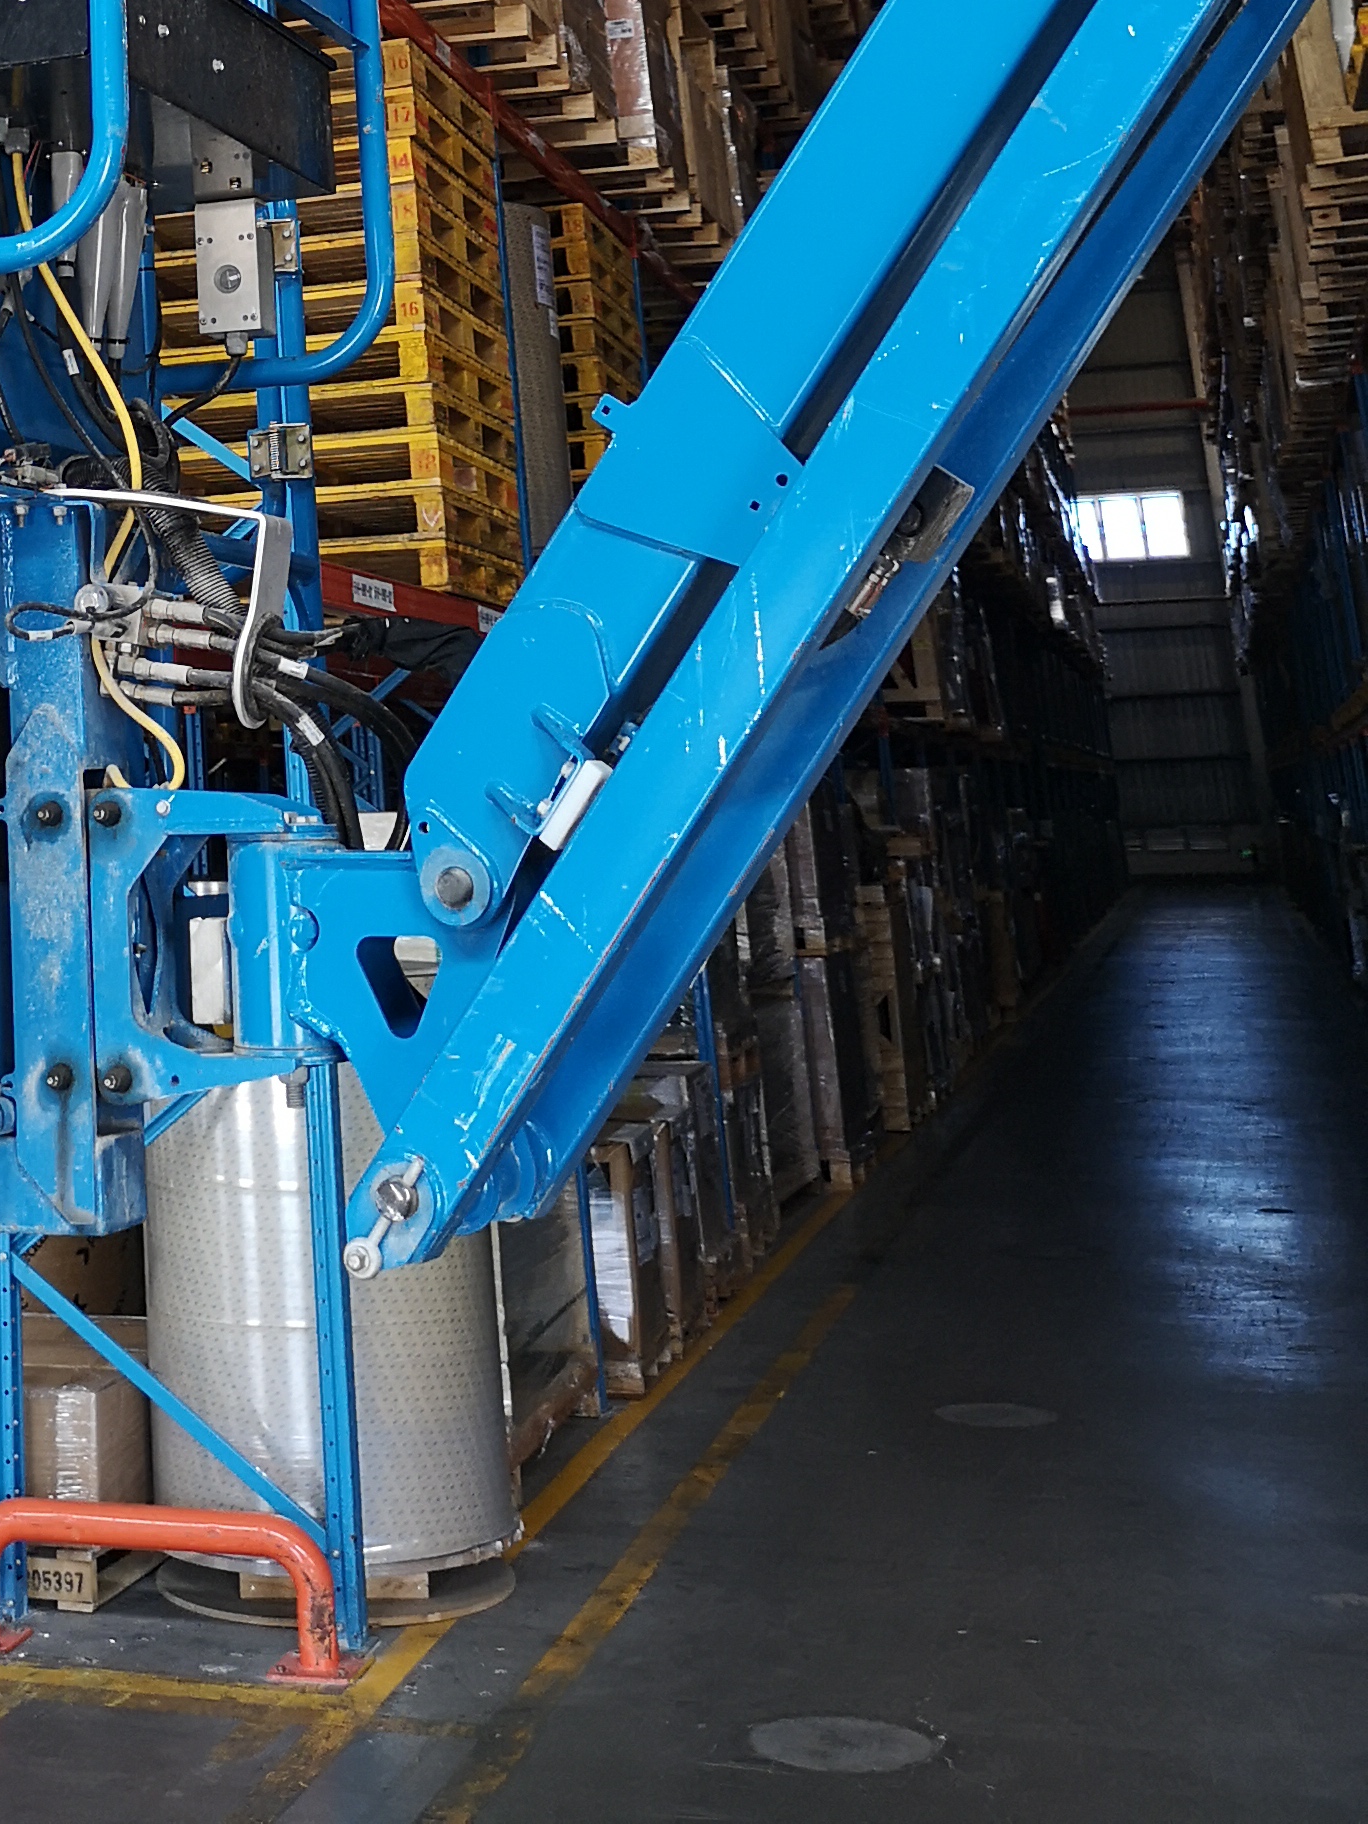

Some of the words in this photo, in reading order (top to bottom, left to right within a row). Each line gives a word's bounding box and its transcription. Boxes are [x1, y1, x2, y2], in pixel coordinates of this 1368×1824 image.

[392, 106, 410, 123] 17
[391, 152, 409, 171] 14
[400, 301, 419, 318] 16
[28, 1568, 84, 1594] 05397
